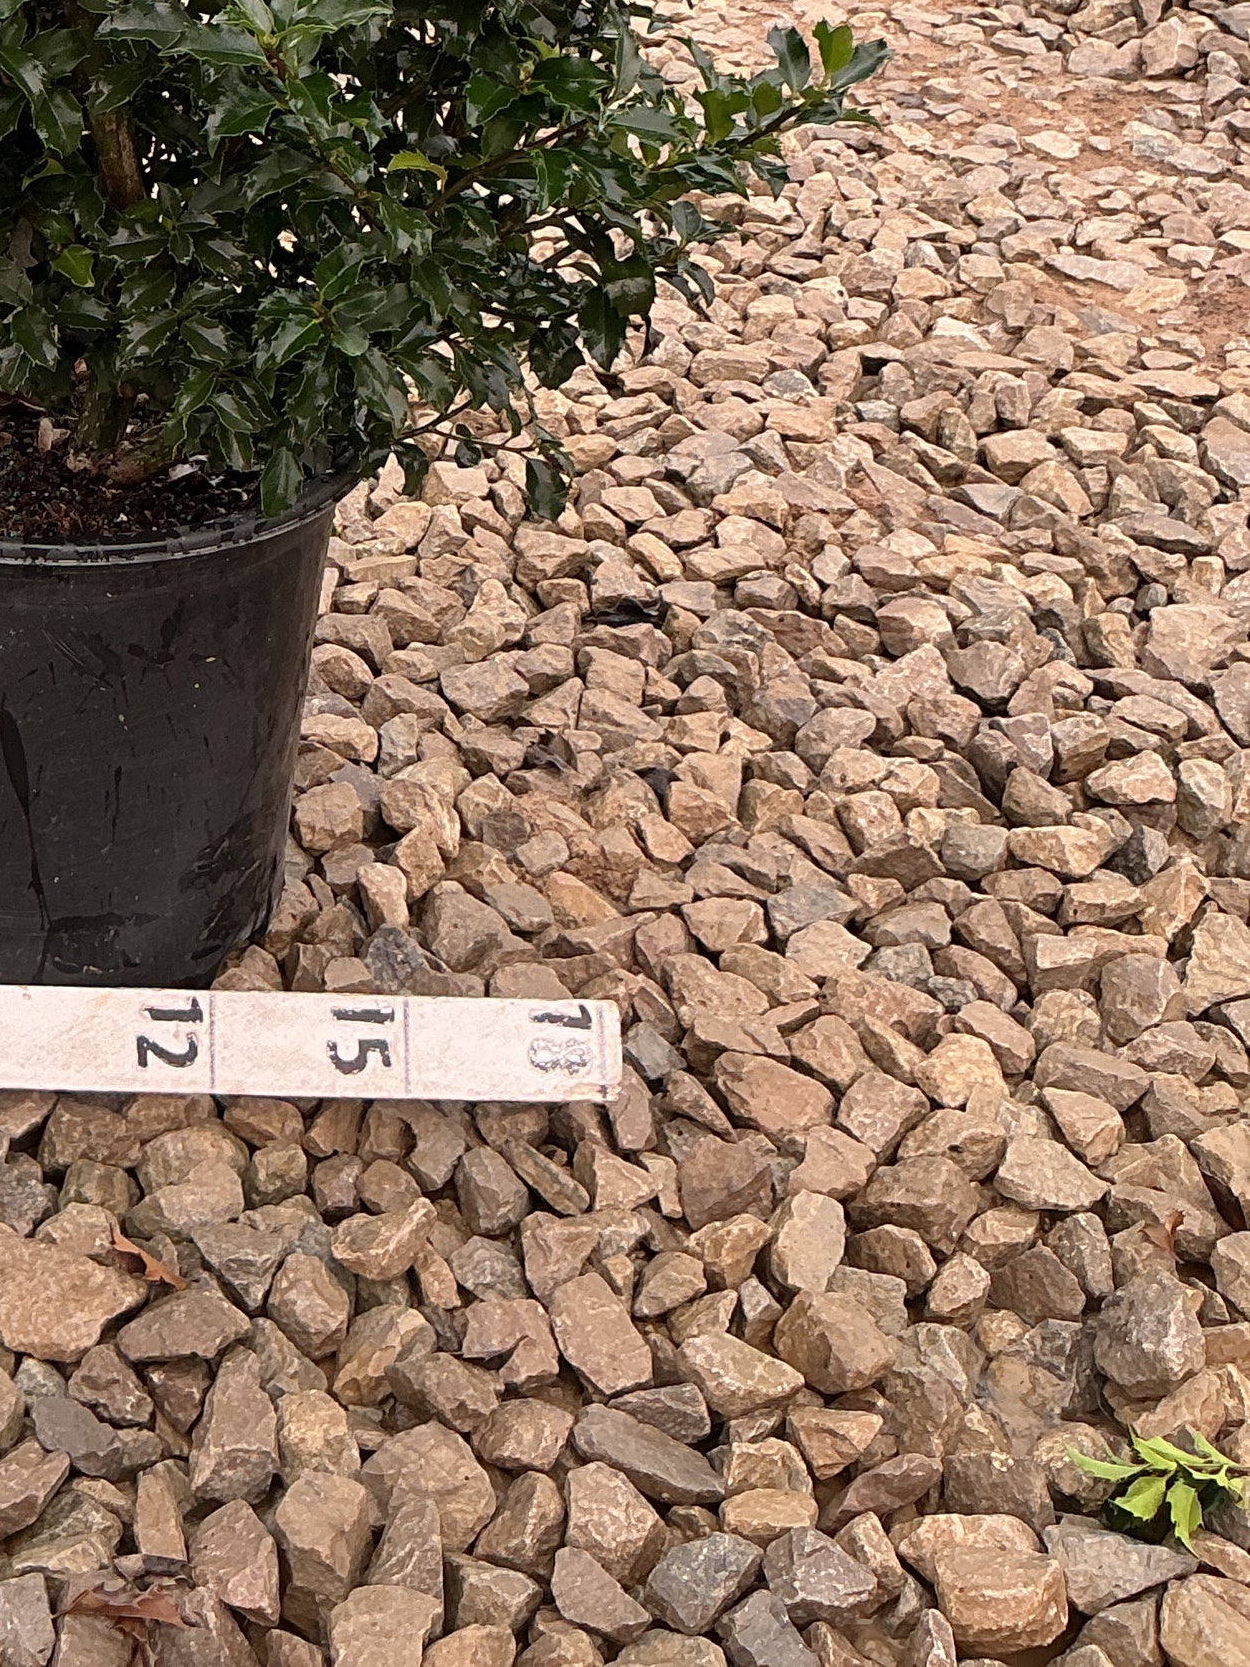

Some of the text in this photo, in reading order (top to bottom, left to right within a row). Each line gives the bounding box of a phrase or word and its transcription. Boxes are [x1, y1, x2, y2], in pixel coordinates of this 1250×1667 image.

[137, 996, 203, 1068] 12
[327, 1006, 395, 1075] 15
[528, 1004, 592, 1075] 18
